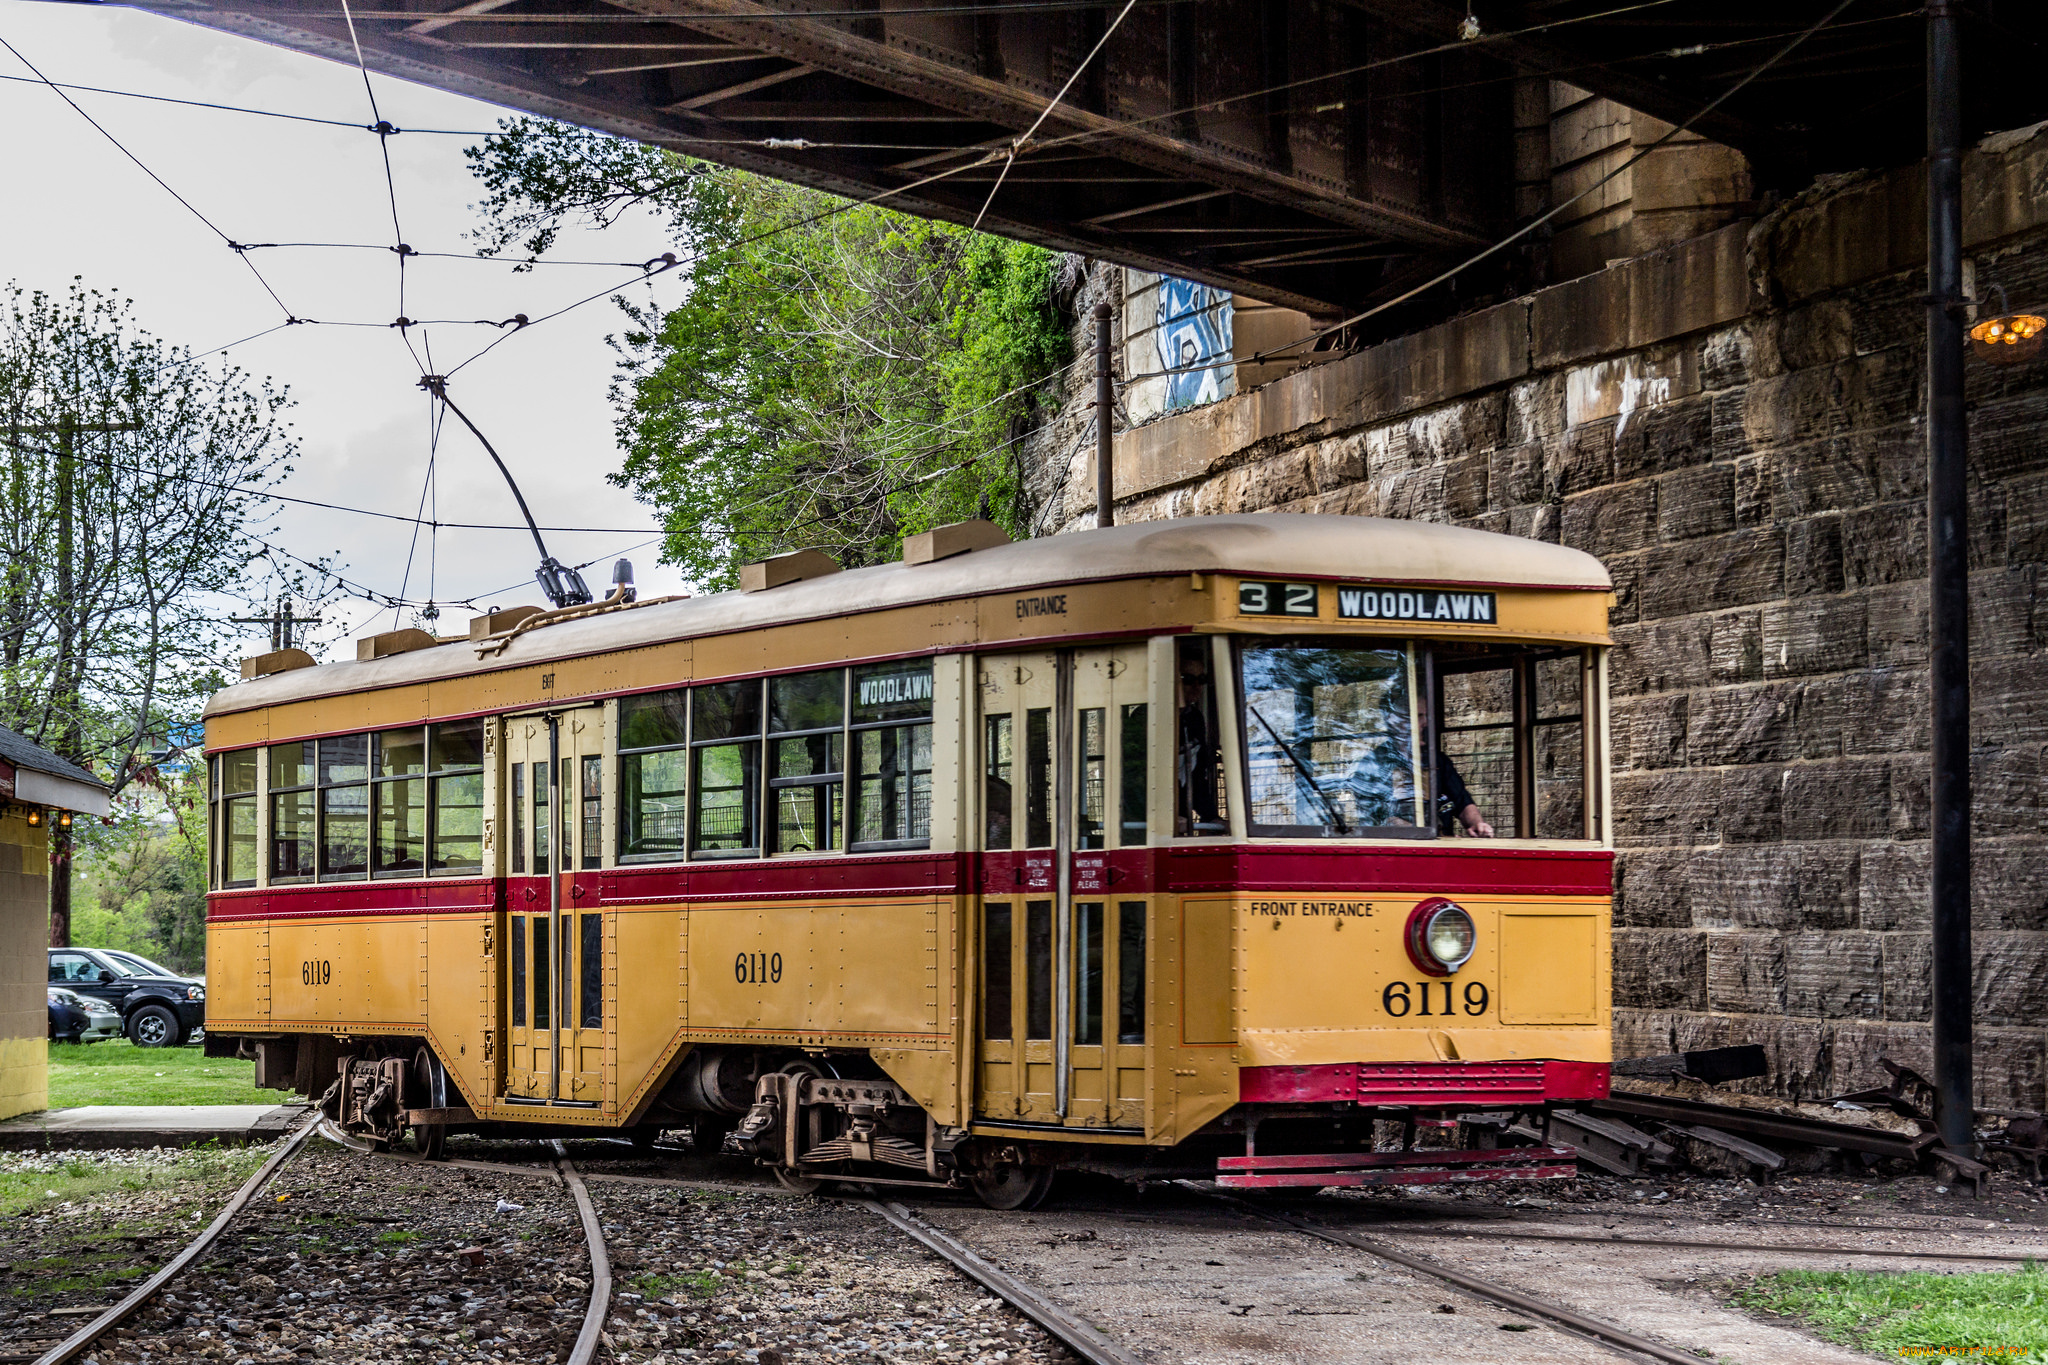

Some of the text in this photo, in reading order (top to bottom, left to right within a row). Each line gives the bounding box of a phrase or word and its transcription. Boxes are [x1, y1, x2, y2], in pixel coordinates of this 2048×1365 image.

[1016, 594, 1067, 618] ENTRANCE
[1340, 590, 1490, 621] WOODLAWN
[542, 673, 556, 690] EXIT
[860, 674, 932, 705] WOODLAWN
[1077, 880, 1100, 889] PLEASE
[1081, 870, 1096, 879] STEP
[1251, 902, 1373, 917] FRONT ENTRANCE
[302, 960, 331, 985] 6119
[735, 952, 783, 984] 6119
[1382, 981, 1489, 1017] 6119
